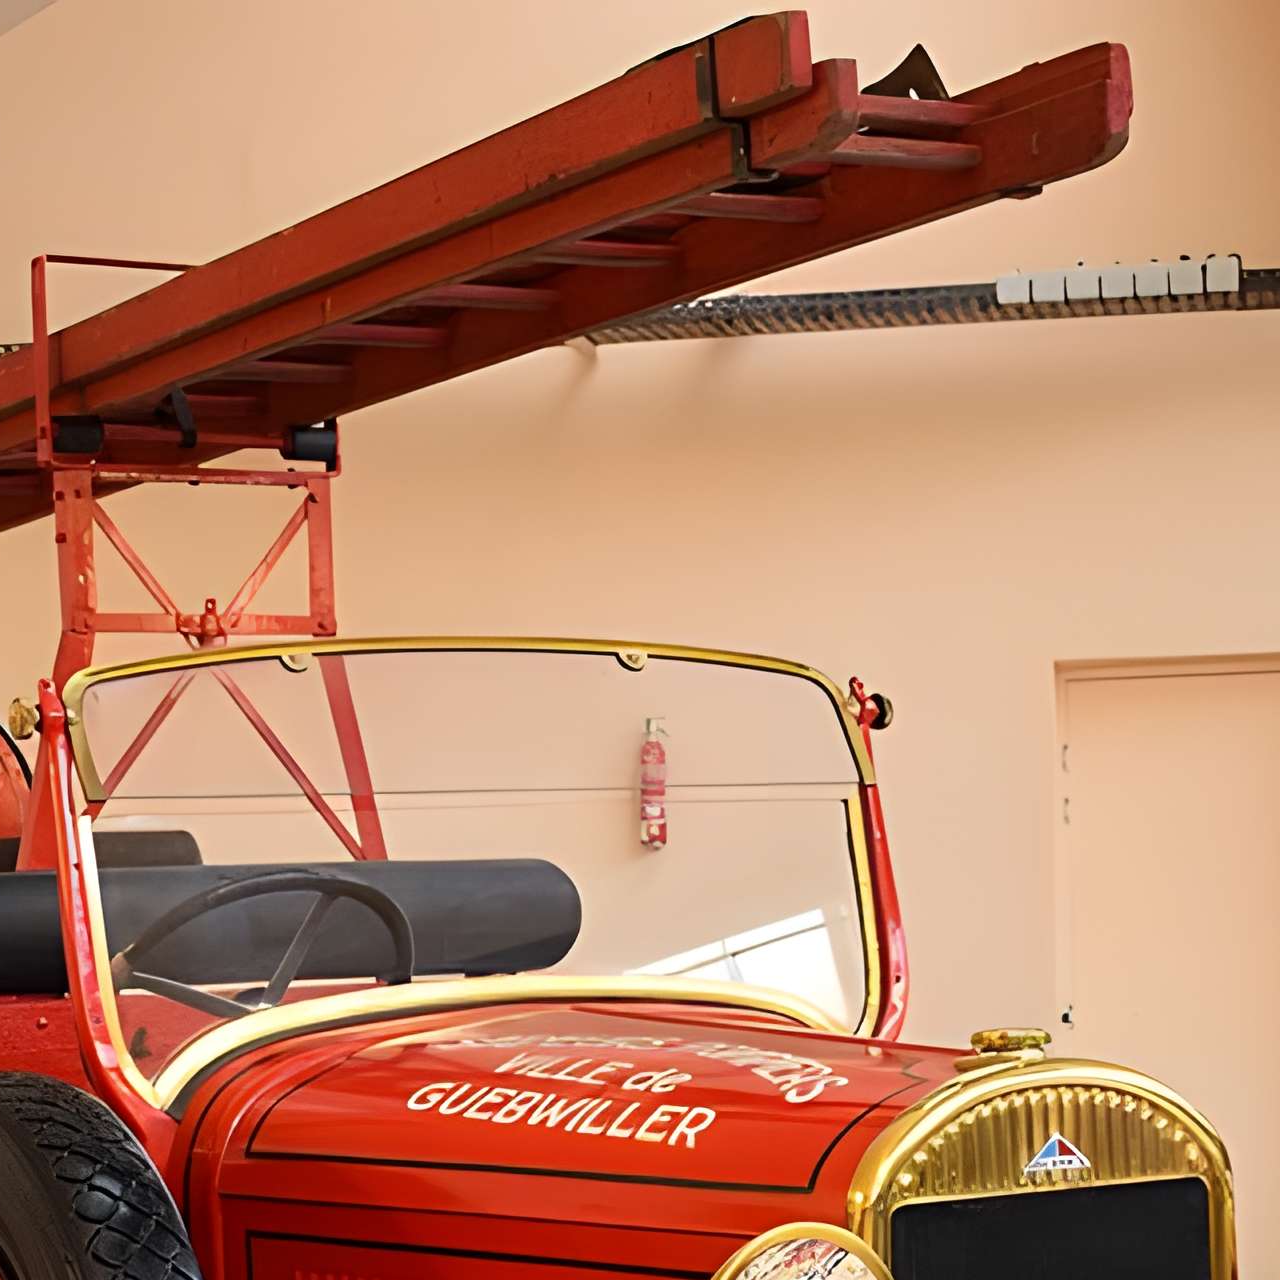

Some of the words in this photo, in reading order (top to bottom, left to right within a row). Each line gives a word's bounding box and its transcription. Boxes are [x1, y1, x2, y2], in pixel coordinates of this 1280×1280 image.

[493, 1051, 634, 1087] VILLE
[620, 1067, 693, 1094] de
[406, 1081, 717, 1150] GUEBWILLER
